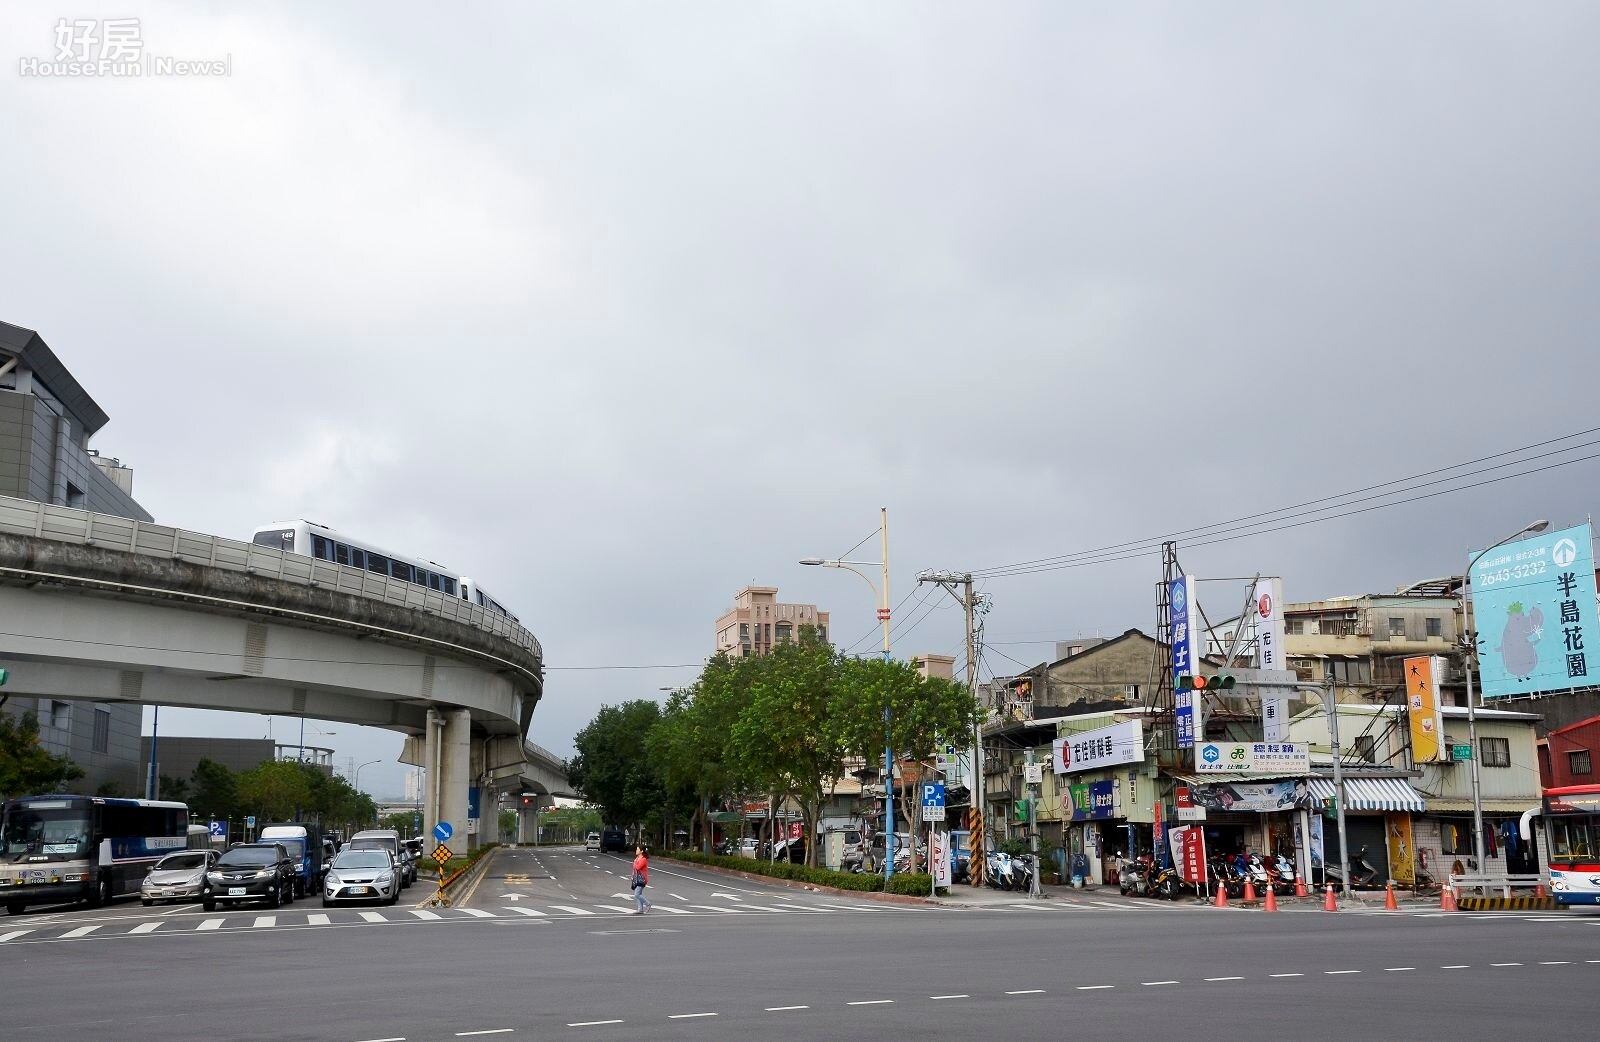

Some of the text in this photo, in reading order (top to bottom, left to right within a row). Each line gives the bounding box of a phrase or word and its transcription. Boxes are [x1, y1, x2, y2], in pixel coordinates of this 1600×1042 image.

[1479, 560, 1547, 586] 2643-3232
[1556, 572, 1588, 678] 半島花園
[1253, 744, 1294, 753] 總經銷
[924, 785, 935, 800] P
[210, 822, 219, 832] P
